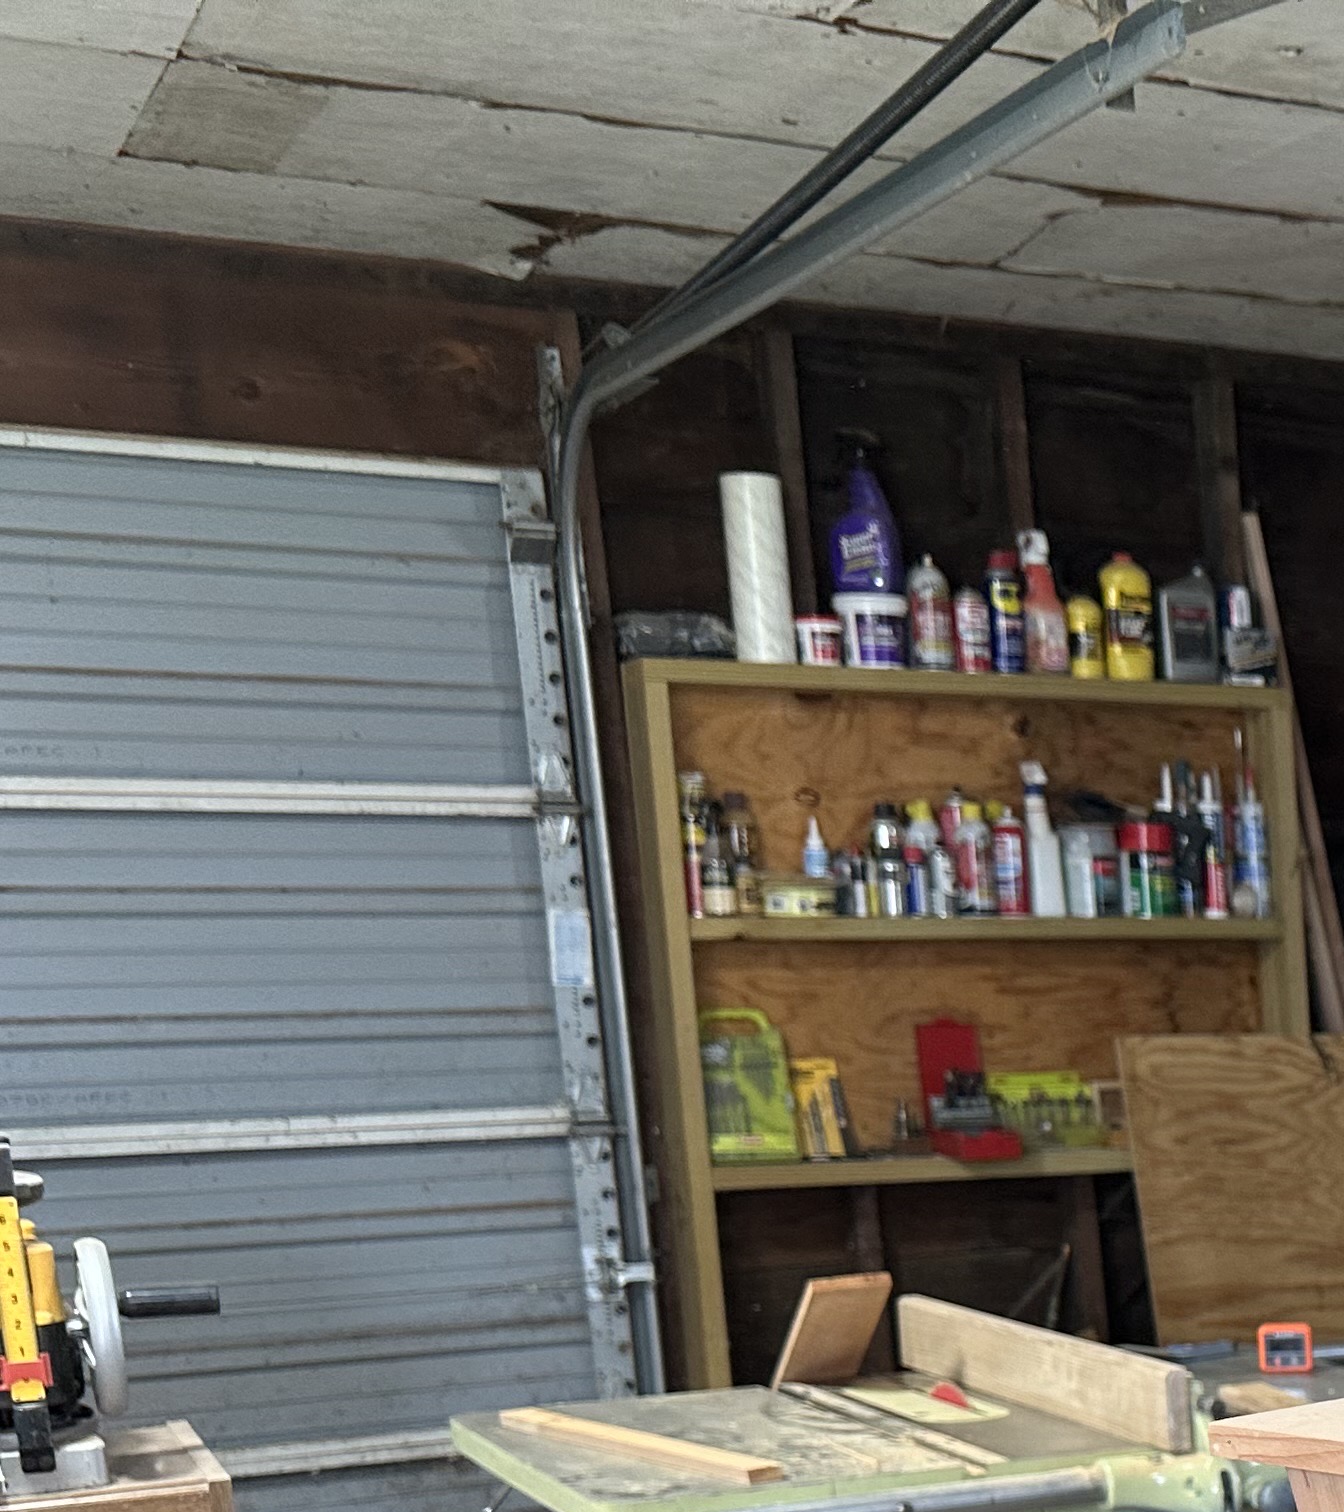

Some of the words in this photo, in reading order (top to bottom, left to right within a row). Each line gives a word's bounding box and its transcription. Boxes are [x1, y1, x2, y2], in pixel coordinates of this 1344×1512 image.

[8, 1267, 14, 1277] 4
[11, 1294, 18, 1305] 3
[15, 1319, 22, 1330] 2
